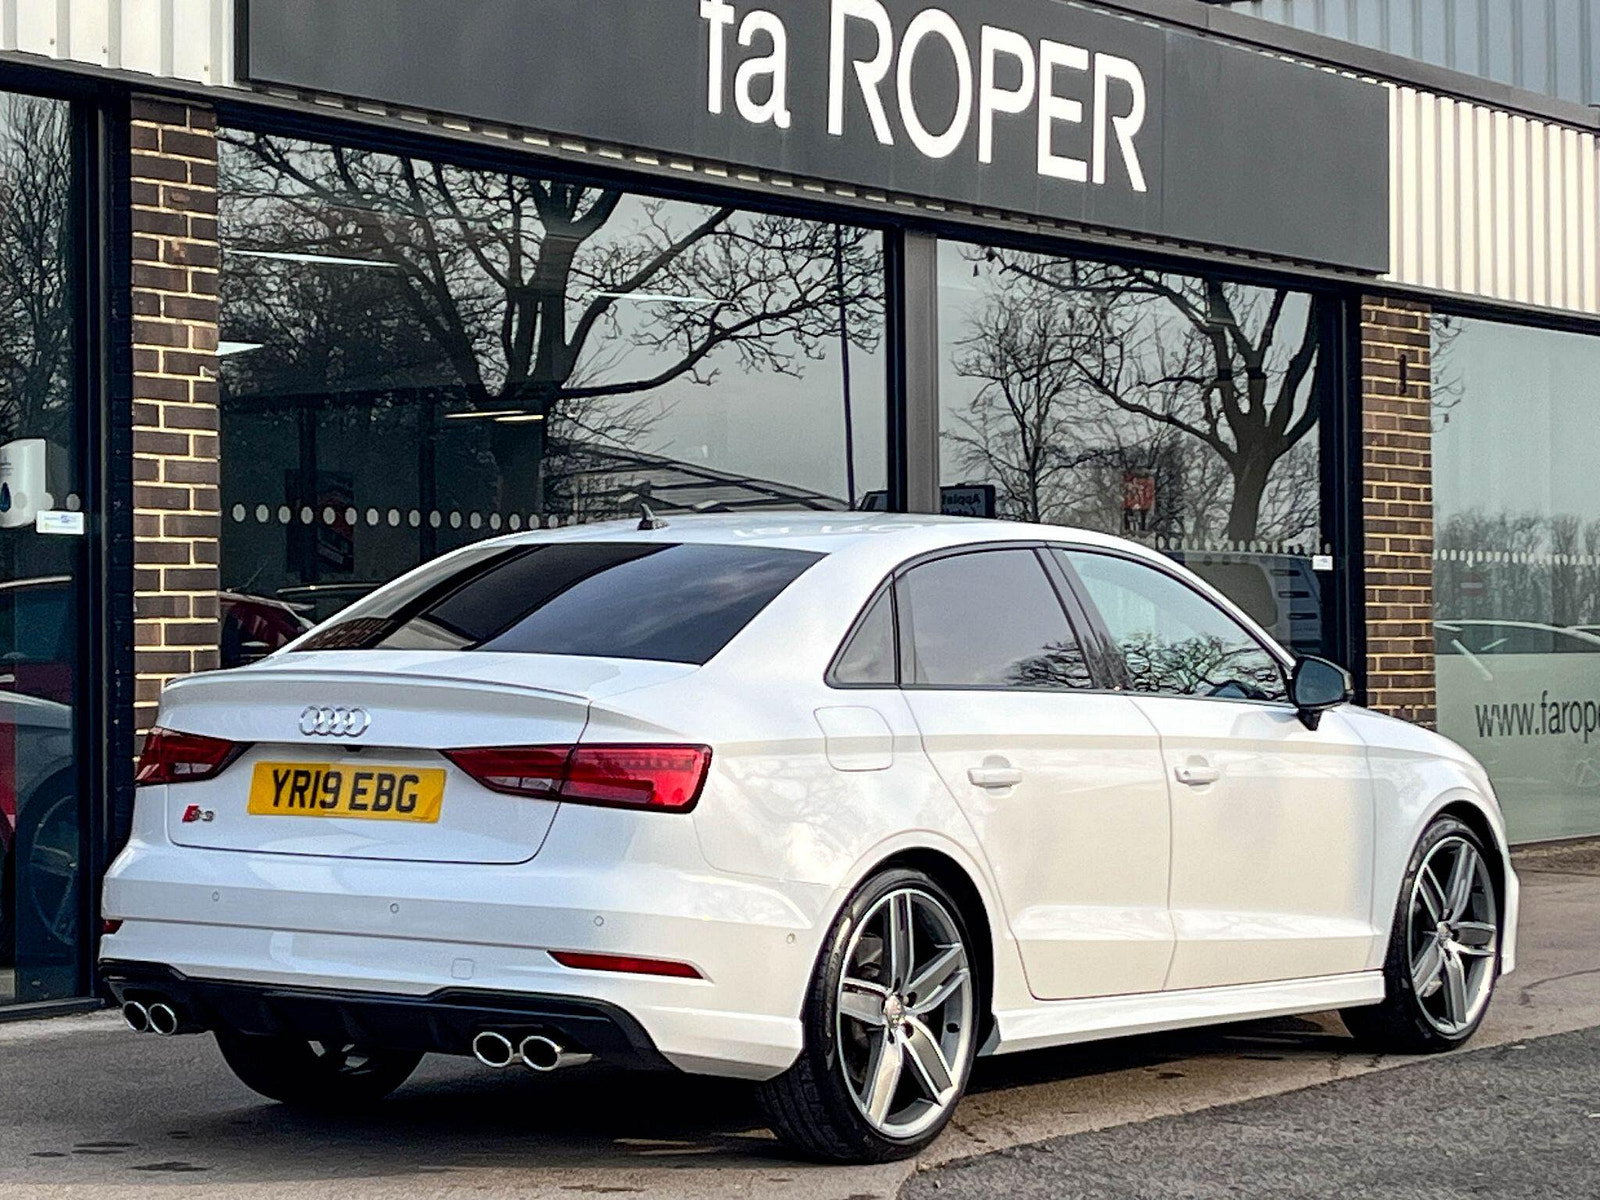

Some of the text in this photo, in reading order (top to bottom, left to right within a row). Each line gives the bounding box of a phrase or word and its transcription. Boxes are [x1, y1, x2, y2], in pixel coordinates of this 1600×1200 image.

[827, 0, 1147, 192] ROPER
[1475, 690, 1600, 743] www.farop
[272, 768, 419, 813] YR19 EBG
